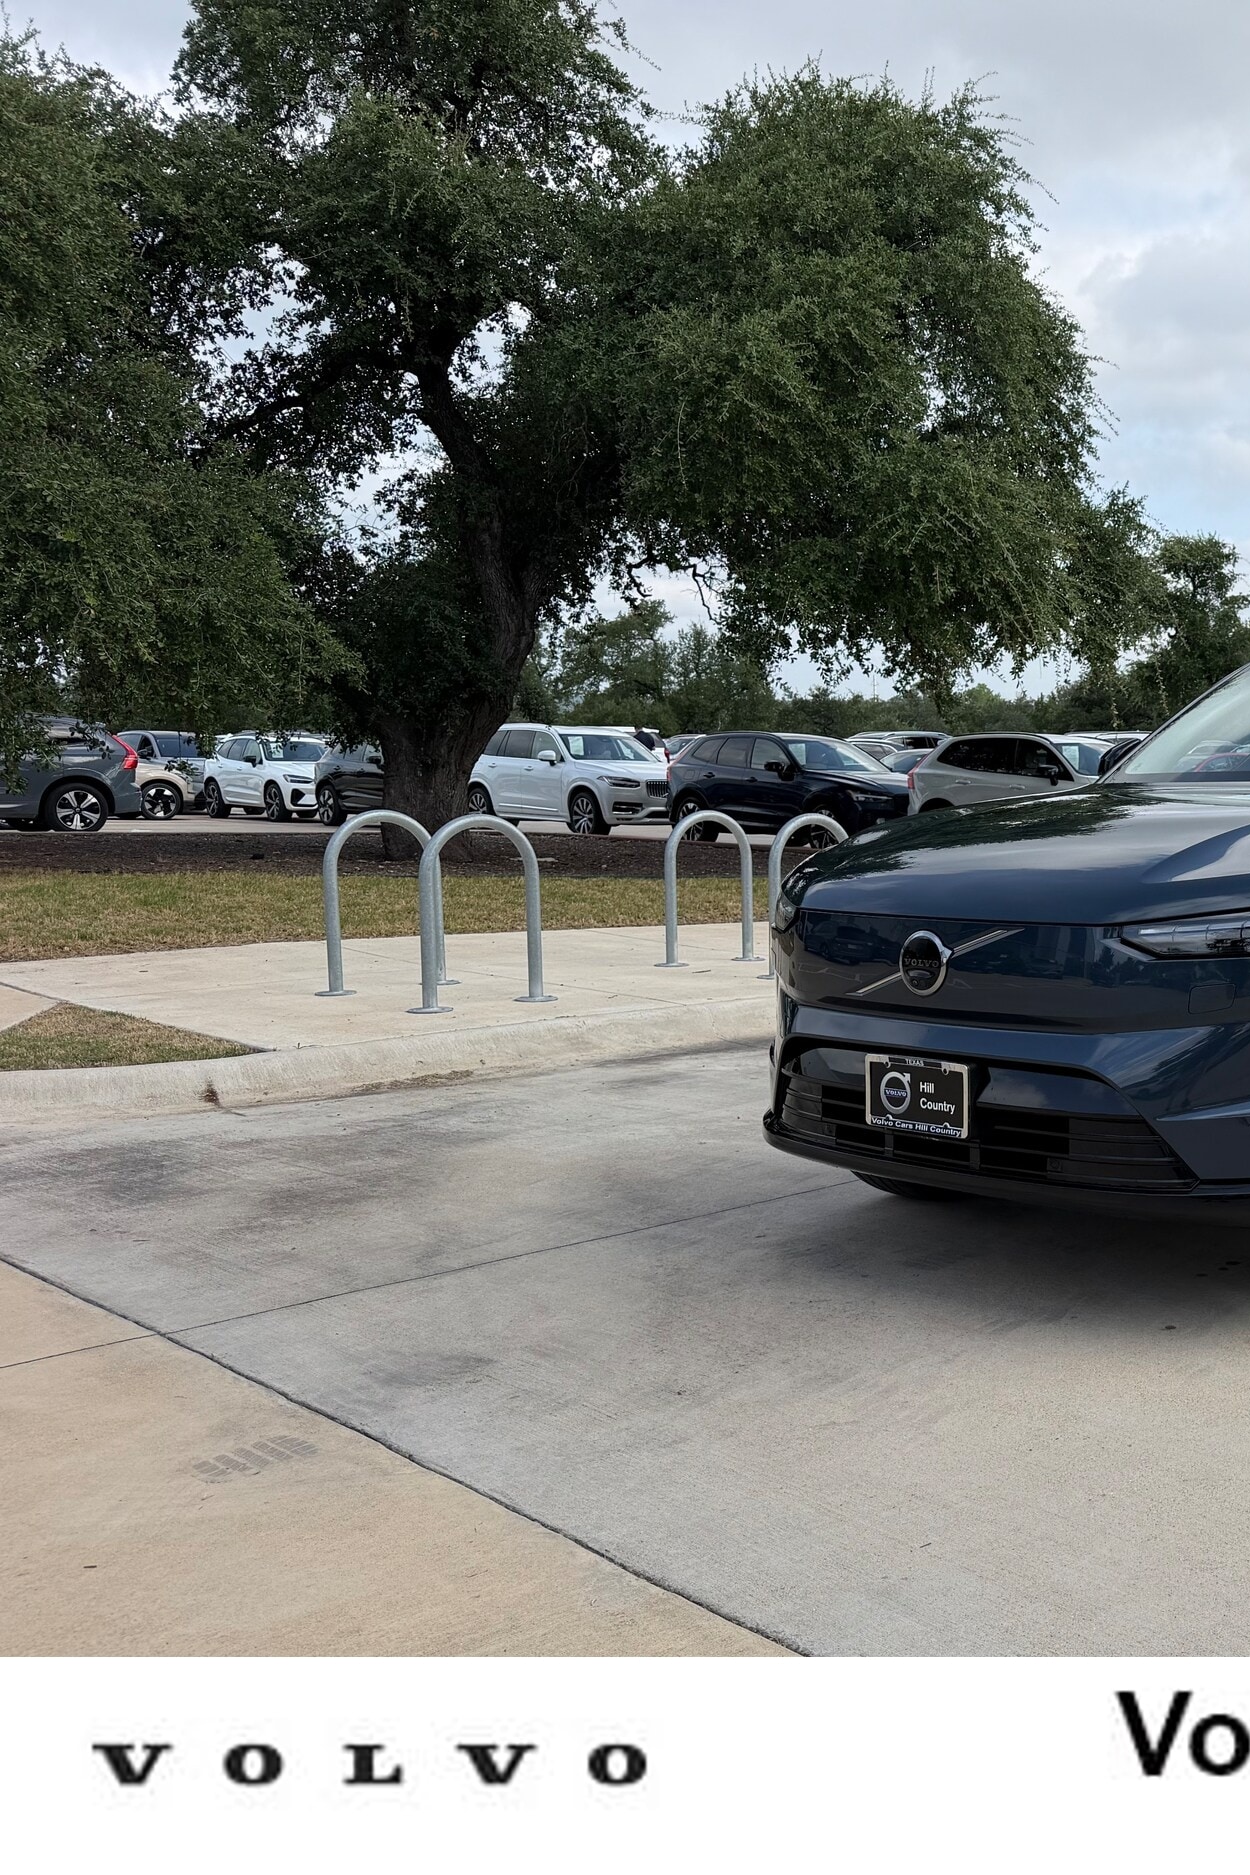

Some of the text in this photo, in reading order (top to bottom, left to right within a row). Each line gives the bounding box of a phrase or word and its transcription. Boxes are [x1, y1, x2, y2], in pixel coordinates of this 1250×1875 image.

[904, 957, 940, 968] VOLVO
[905, 1058, 925, 1067] TEXAS
[885, 1089, 907, 1097] VOLVO
[920, 1081, 935, 1094] Hill
[920, 1097, 956, 1115] Country
[871, 1117, 961, 1138] Volvo Cars Hill Country
